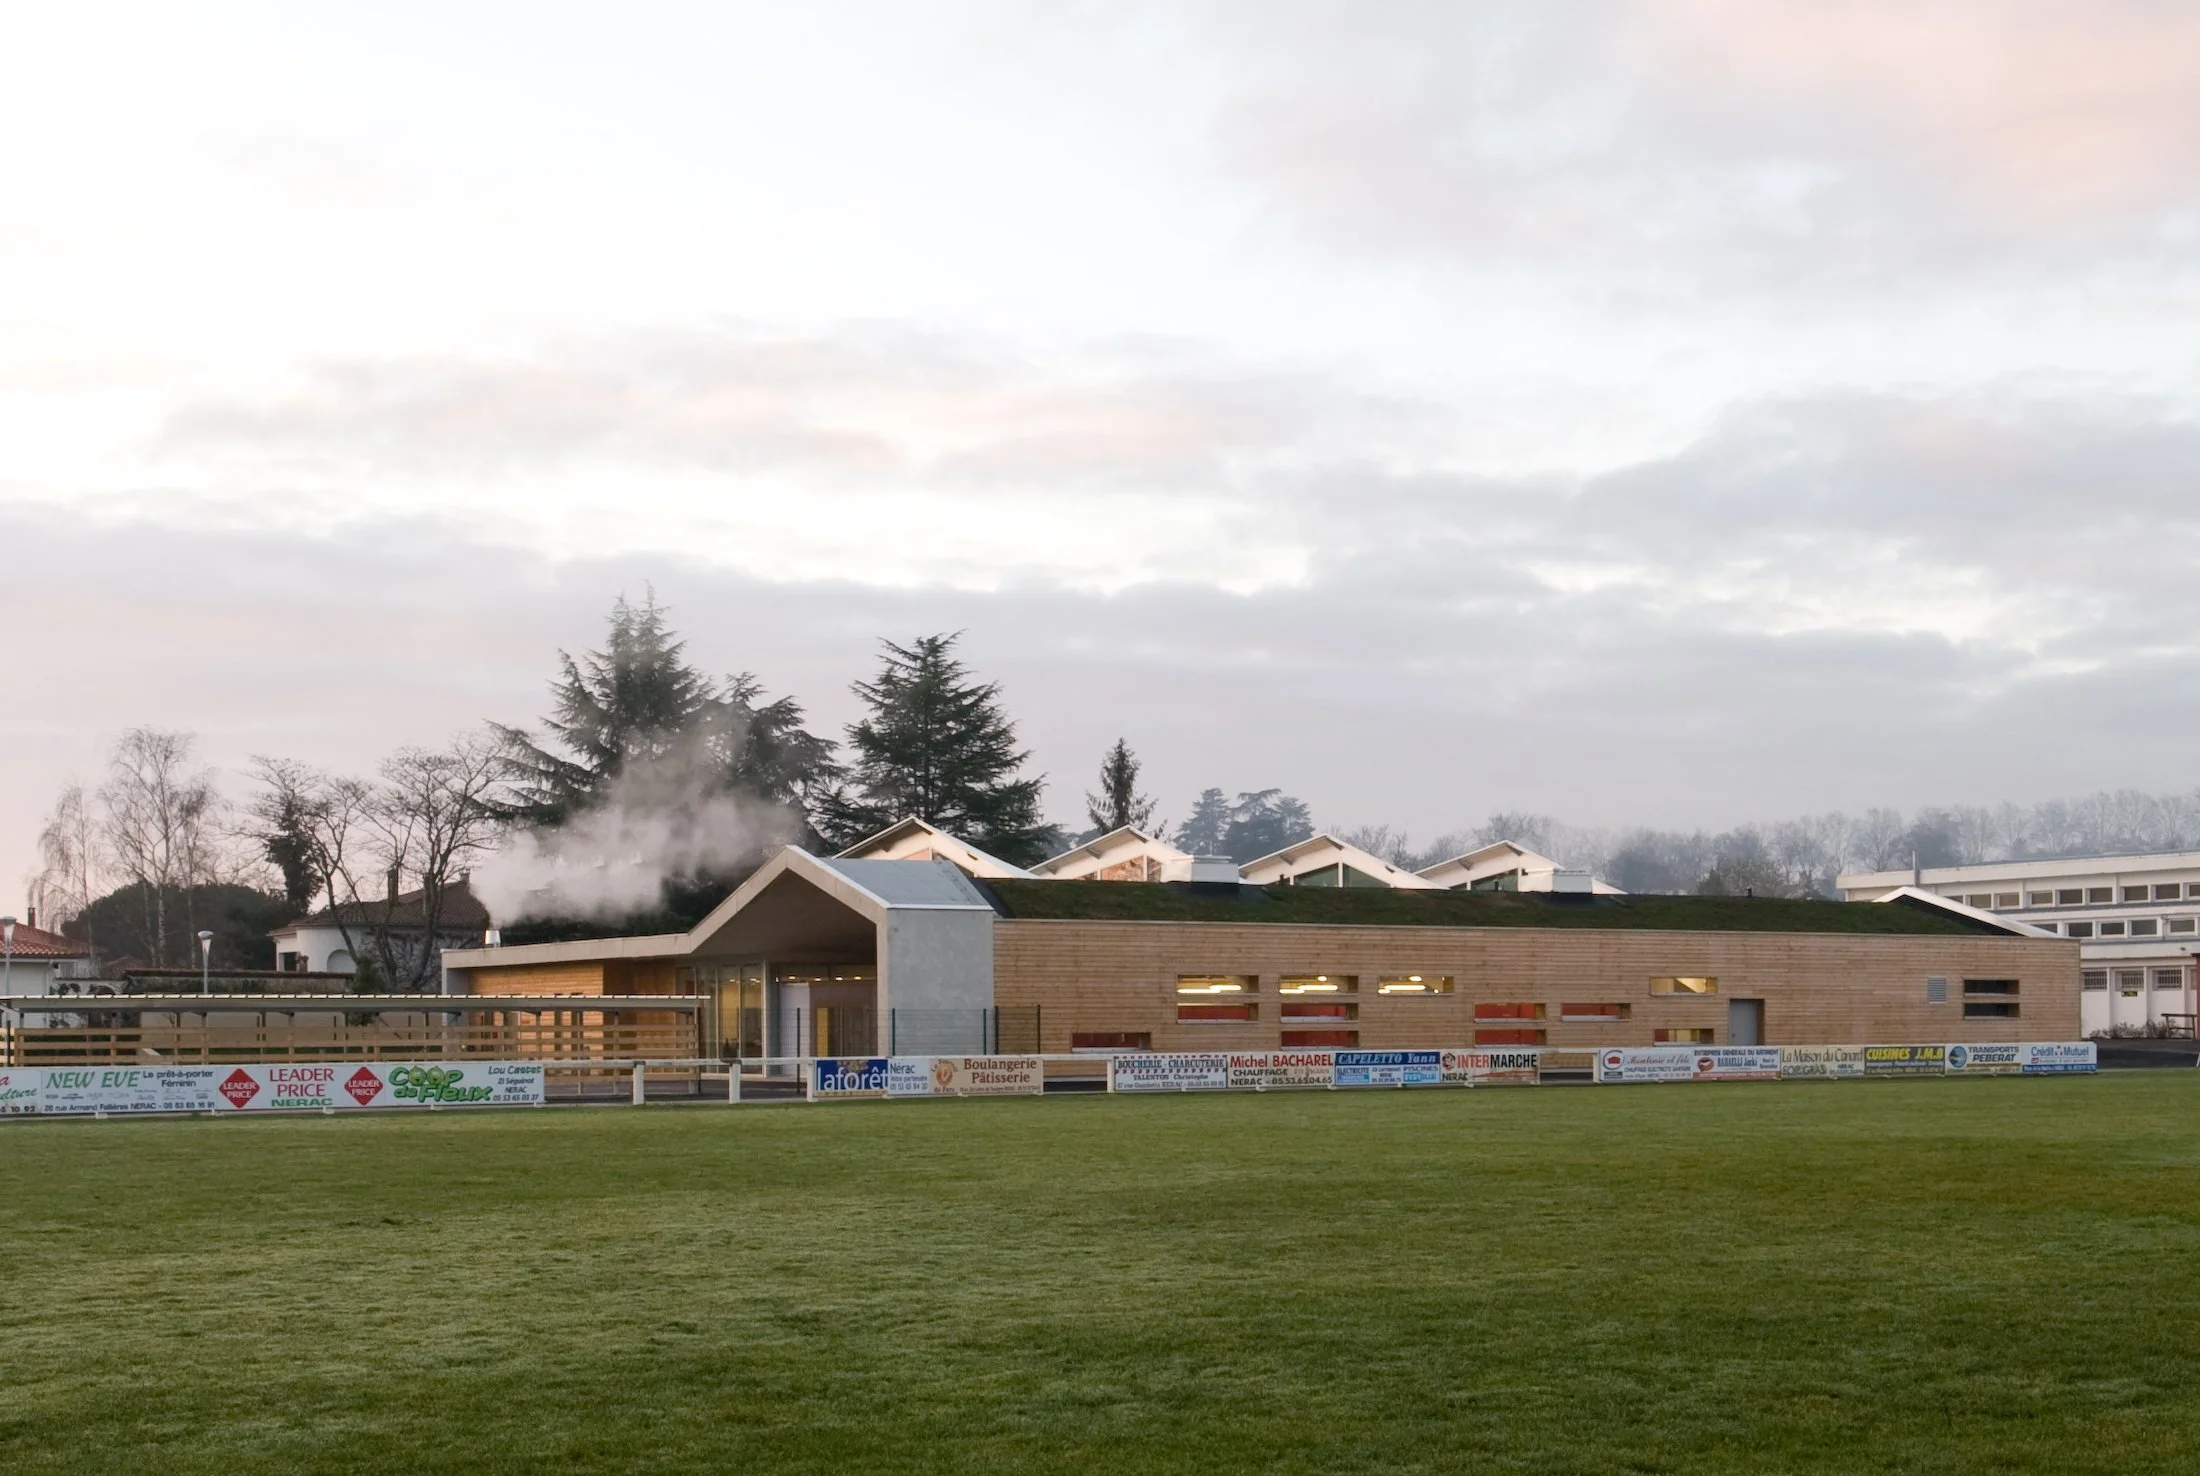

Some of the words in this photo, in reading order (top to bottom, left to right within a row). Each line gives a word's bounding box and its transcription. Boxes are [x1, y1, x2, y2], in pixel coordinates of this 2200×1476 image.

[1783, 1049, 1792, 1062] La
[1794, 1048, 1820, 1062] Maison
[1823, 1049, 1833, 1061] du
[1866, 1048, 1910, 1060] CUISINES
[2031, 1046, 2053, 1056] Crédit
[2063, 1046, 2089, 1056] Mutuel
[1231, 1055, 1268, 1068] Michel
[1273, 1054, 1333, 1067] BACHAREL
[1339, 1053, 1402, 1064] CAPELETTO
[1408, 1053, 1436, 1063] Yann
[1457, 1054, 1537, 1069] INTERMARCHE
[1972, 1054, 2016, 1062] PEBERAT
[890, 1062, 915, 1074] Nérac
[964, 1058, 1037, 1072] Boulangerie
[1118, 1060, 1162, 1069] BOUCHERIE
[1168, 1059, 1224, 1068] CHARCUTERIE
[157, 1070, 213, 1080] prêt-à-porter
[270, 1069, 334, 1082] LEADER
[488, 1065, 506, 1075] Lou
[46, 1071, 95, 1089] NEW
[101, 1071, 140, 1088] EVE
[817, 1066, 888, 1091] laforêt
[972, 1071, 1030, 1084] Pâtisserie
[1442, 1073, 1468, 1081] NERAC
[162, 1079, 196, 1087] Féminin
[223, 1081, 256, 1090] LEADER
[348, 1079, 379, 1088] LEADER
[227, 1090, 251, 1099] PRICE
[277, 1084, 325, 1097] PRICE
[271, 1098, 333, 1107] NERAC
